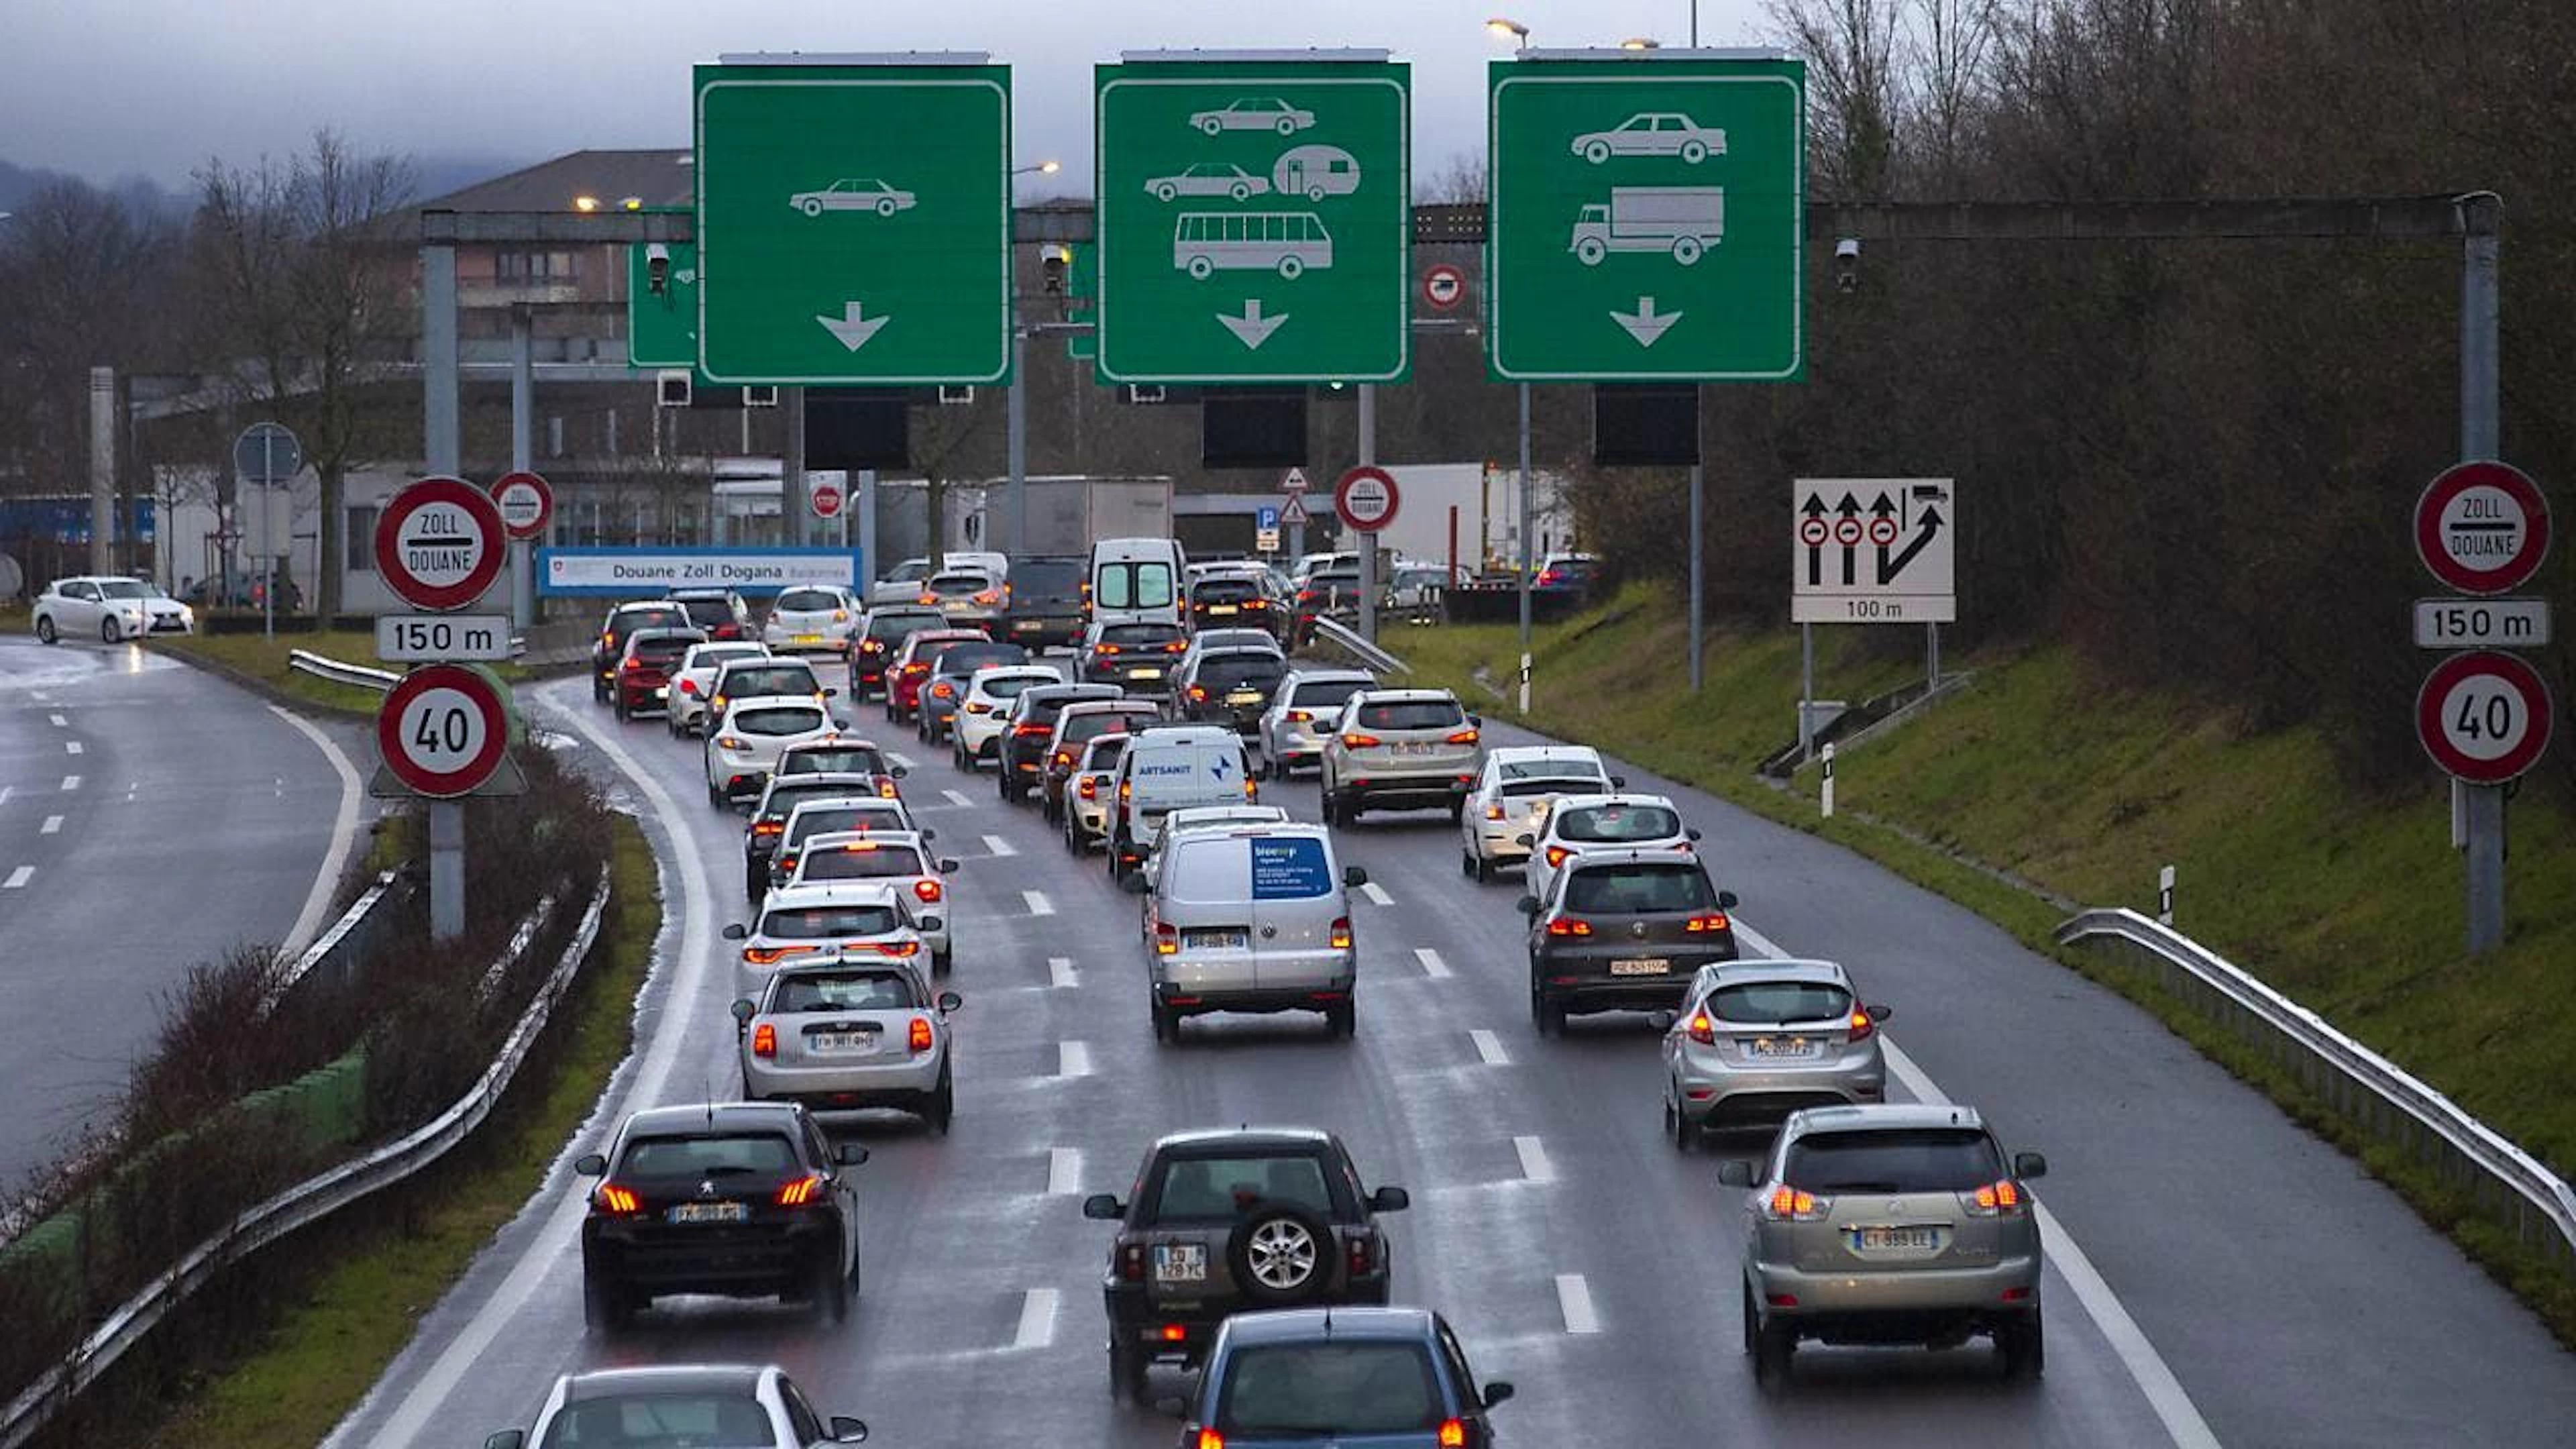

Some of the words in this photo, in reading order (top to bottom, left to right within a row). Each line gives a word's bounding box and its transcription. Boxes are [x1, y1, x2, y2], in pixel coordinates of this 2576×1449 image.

[2463, 498, 2502, 518] ZOLL
[421, 513, 459, 534] ZOLL
[1263, 510, 1275, 529] P
[2452, 535, 2516, 555] DOUANE
[409, 549, 472, 572] DOUANE
[612, 564, 676, 579] Douane
[684, 564, 714, 579] Zoll
[721, 564, 783, 582] Dogana
[1848, 600, 1880, 616] 100
[1886, 604, 1902, 616] m
[2434, 609, 2490, 637] 150
[2504, 615, 2532, 637] m
[396, 623, 451, 651] 150
[466, 629, 492, 651] m
[2457, 694, 2510, 741] 40
[416, 708, 469, 753] 40
